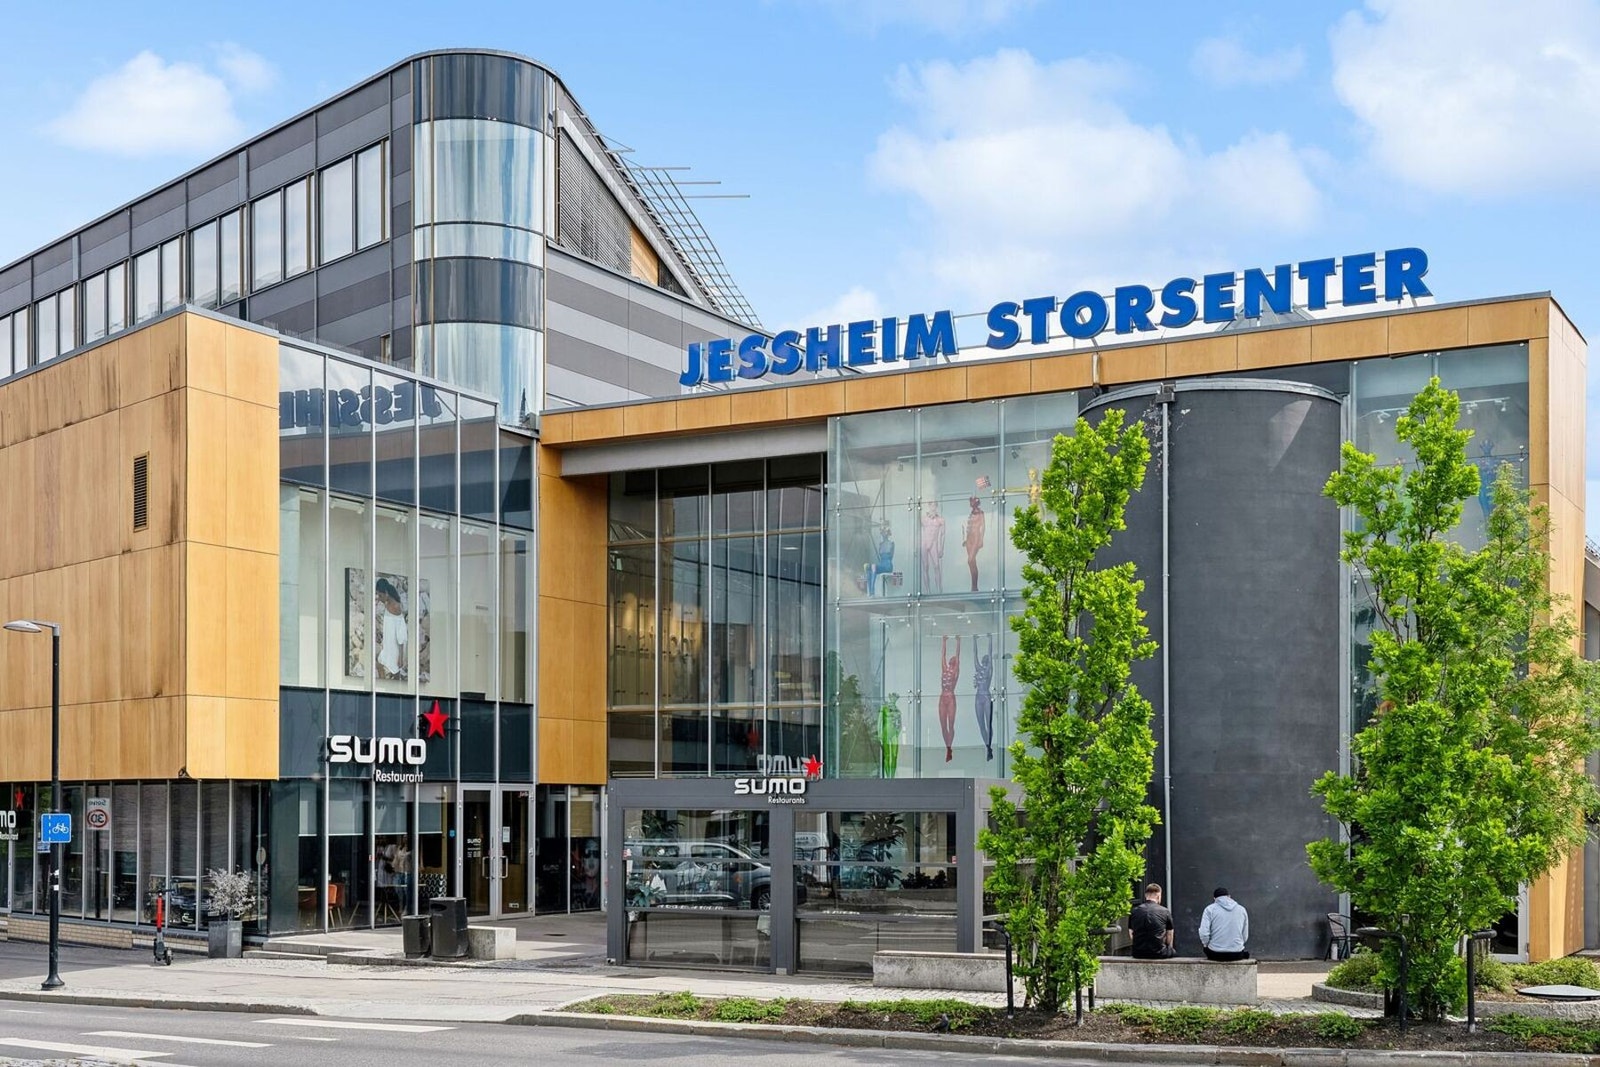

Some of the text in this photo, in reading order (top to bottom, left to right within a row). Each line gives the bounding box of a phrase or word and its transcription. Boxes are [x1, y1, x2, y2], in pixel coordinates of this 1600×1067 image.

[680, 246, 1434, 386] JESSHEIM STORSENTER
[329, 735, 427, 764] SUMO
[375, 769, 424, 783] Restaurant
[734, 778, 806, 795] SUMO
[768, 796, 806, 805] Restaurants
